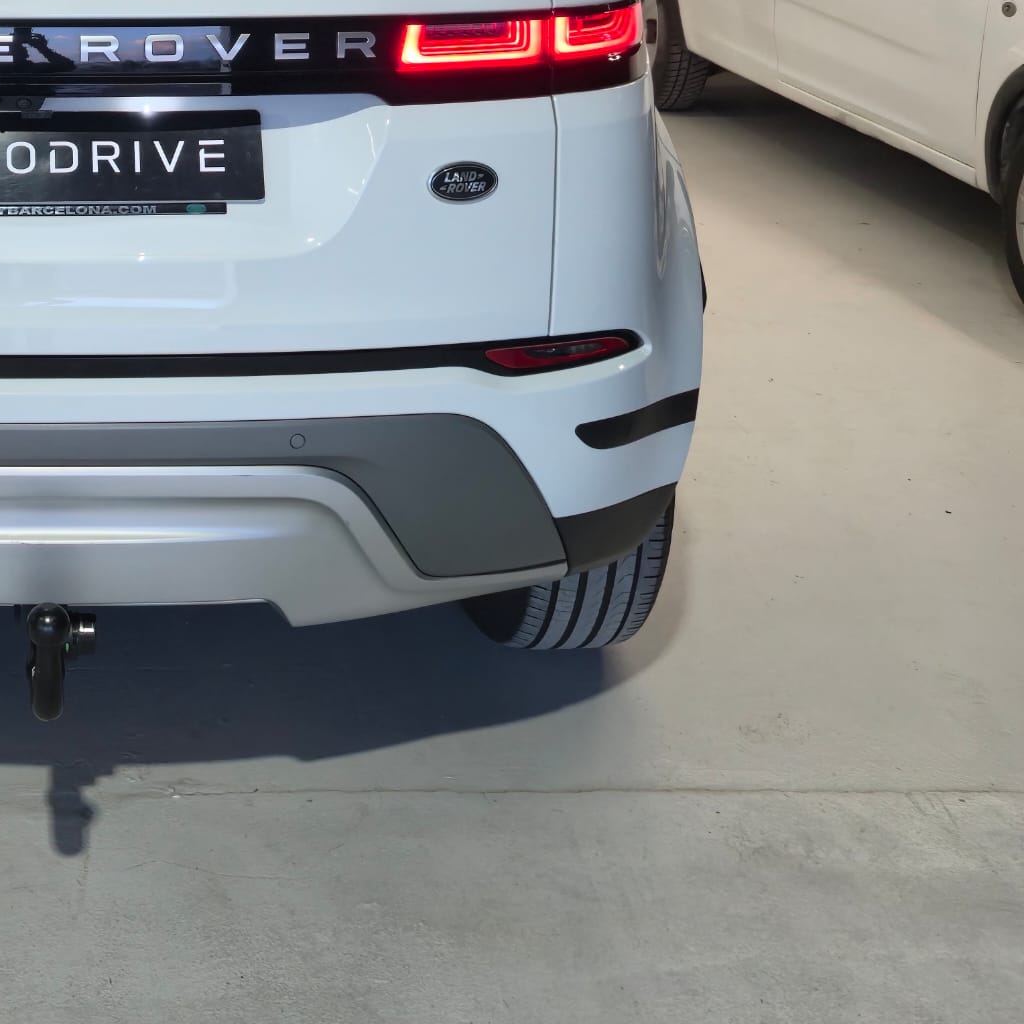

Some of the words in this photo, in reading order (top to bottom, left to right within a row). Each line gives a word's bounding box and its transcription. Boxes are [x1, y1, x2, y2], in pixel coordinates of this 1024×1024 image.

[80, 31, 377, 63] ROVER
[444, 171, 477, 183] LAND
[446, 181, 486, 193] ROVER
